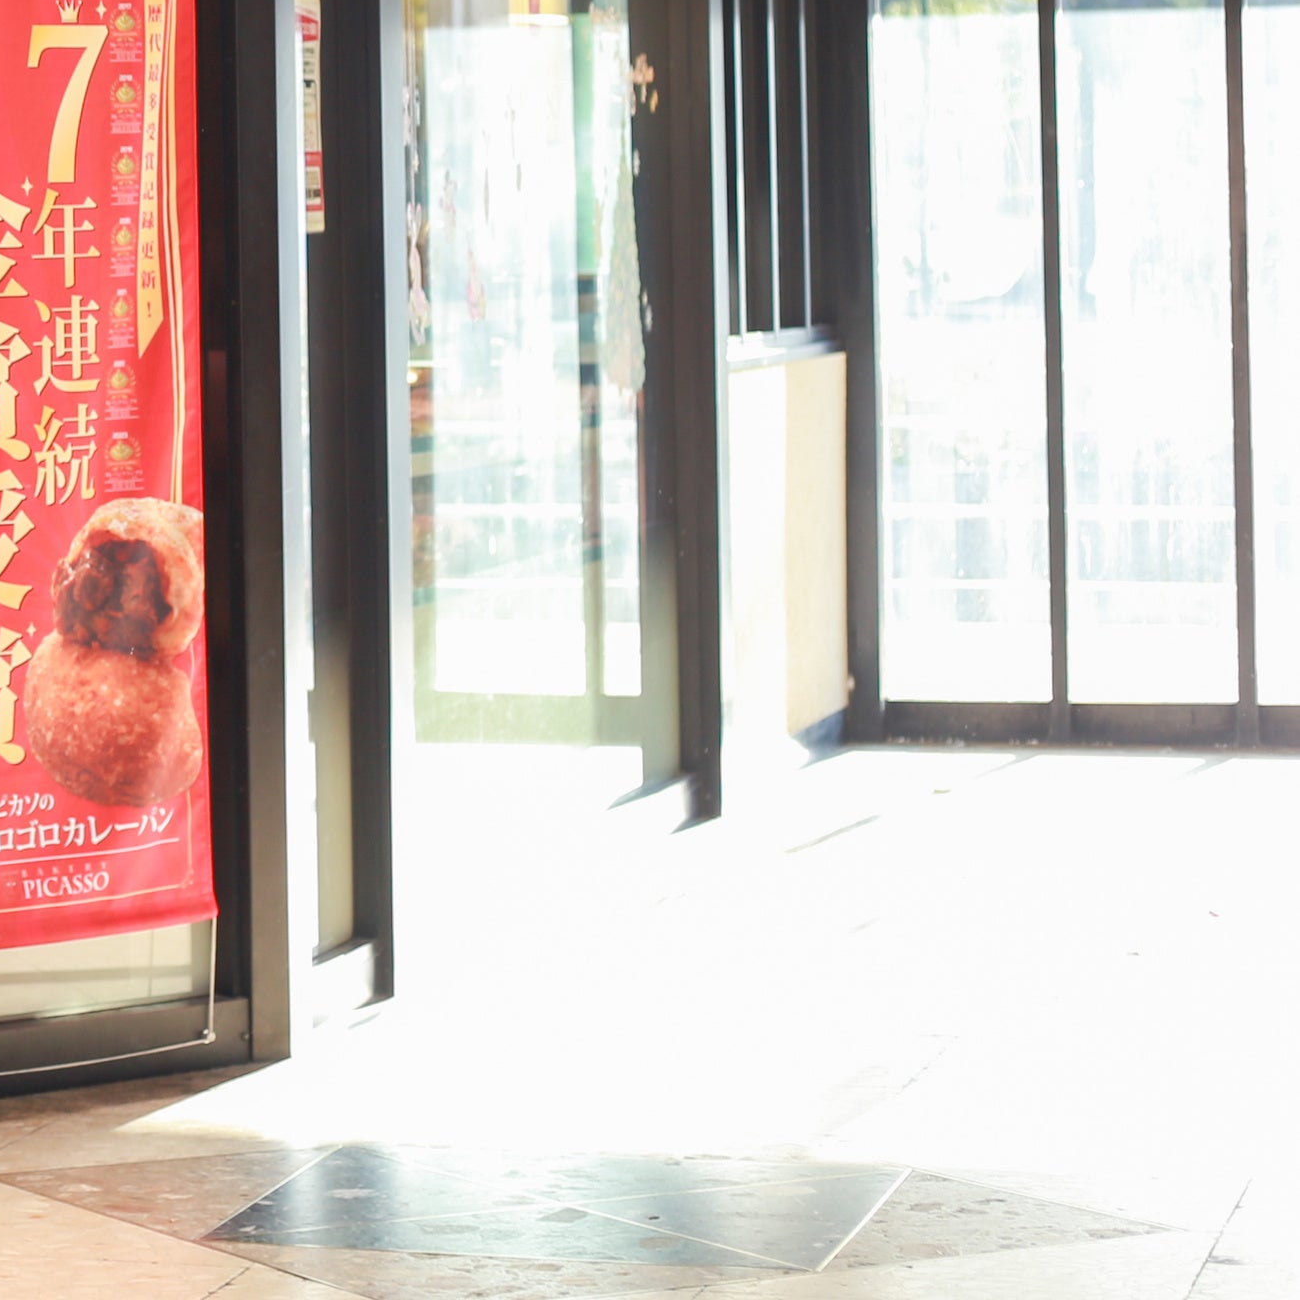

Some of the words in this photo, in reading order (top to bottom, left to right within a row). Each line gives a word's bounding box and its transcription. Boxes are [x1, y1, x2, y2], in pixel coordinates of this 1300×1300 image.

[26, 24, 110, 507] 7年連続
[22, 871, 110, 900] PICASSO
